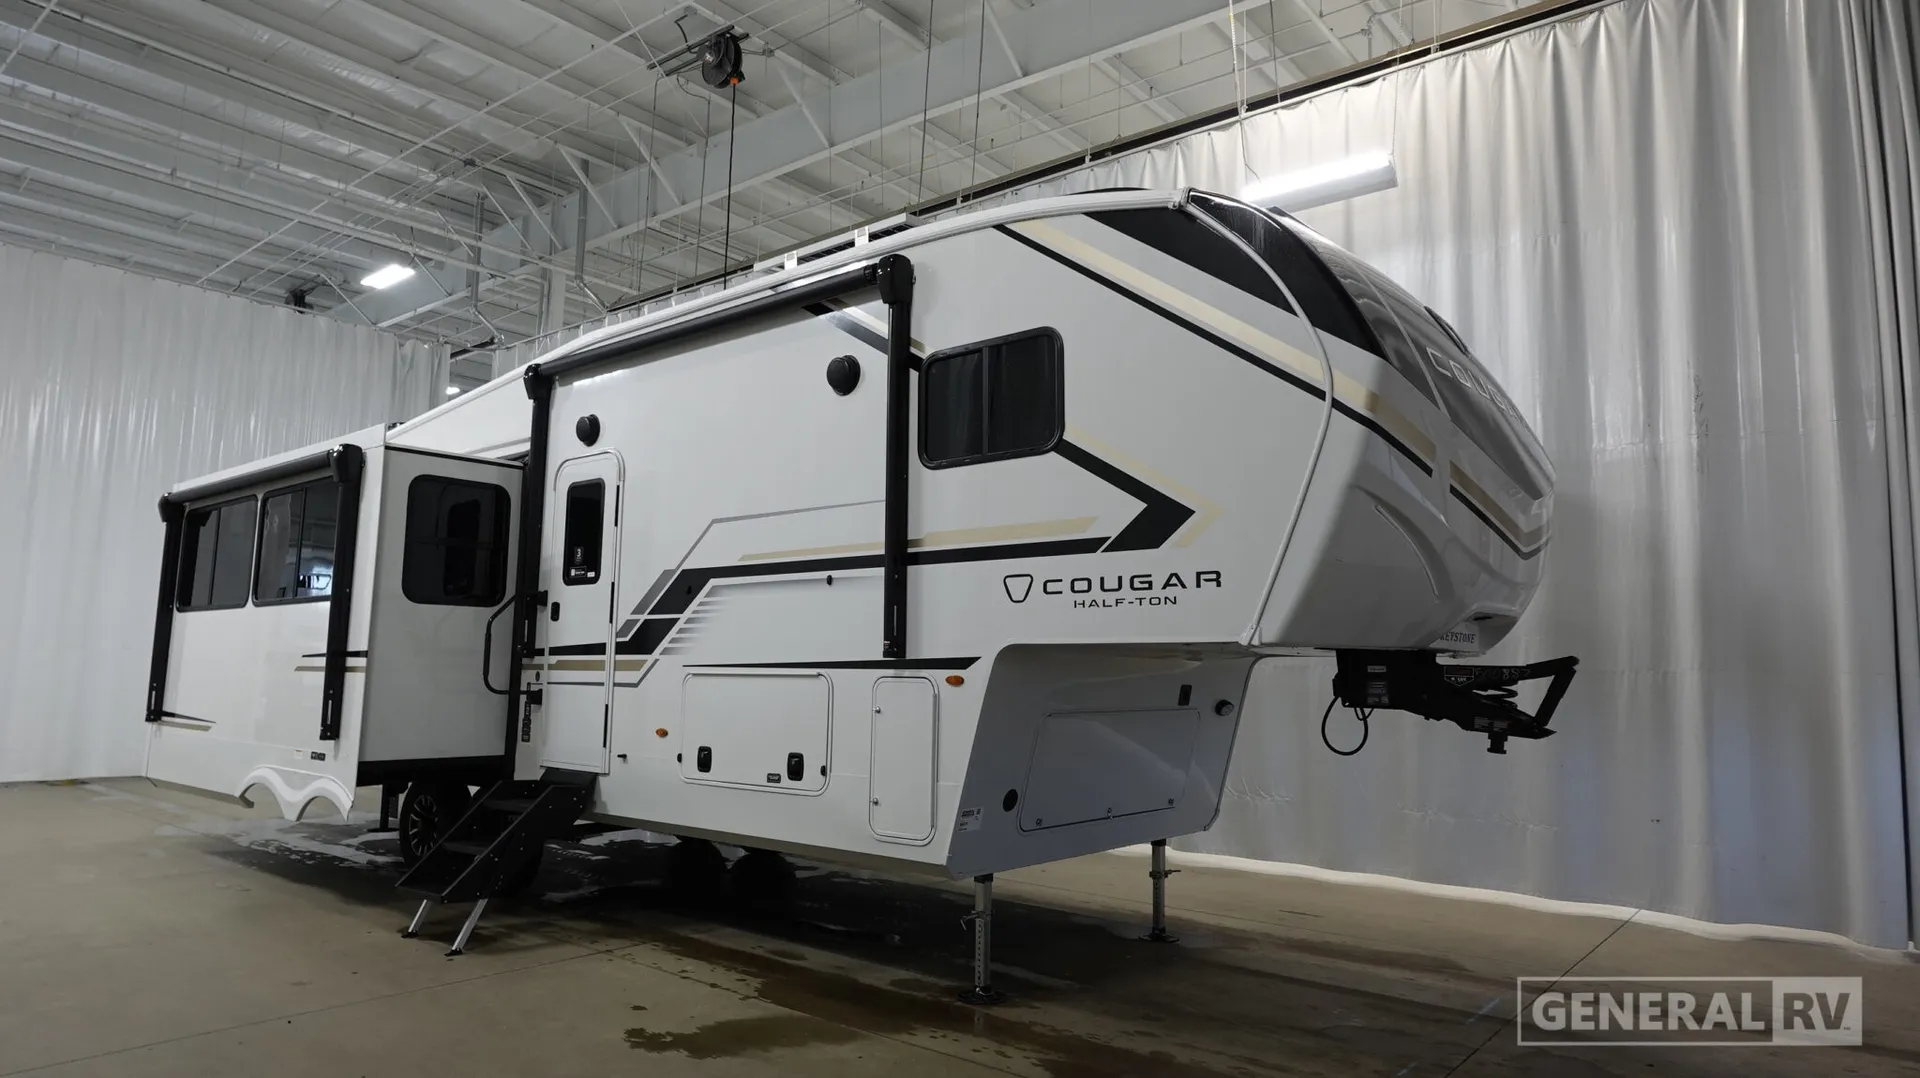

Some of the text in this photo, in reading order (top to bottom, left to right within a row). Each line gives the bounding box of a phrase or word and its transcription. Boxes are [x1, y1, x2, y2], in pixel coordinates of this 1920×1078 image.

[1425, 347, 1521, 421] COUG
[1043, 570, 1221, 594] COUGAR
[1073, 596, 1177, 609] HALF-TON
